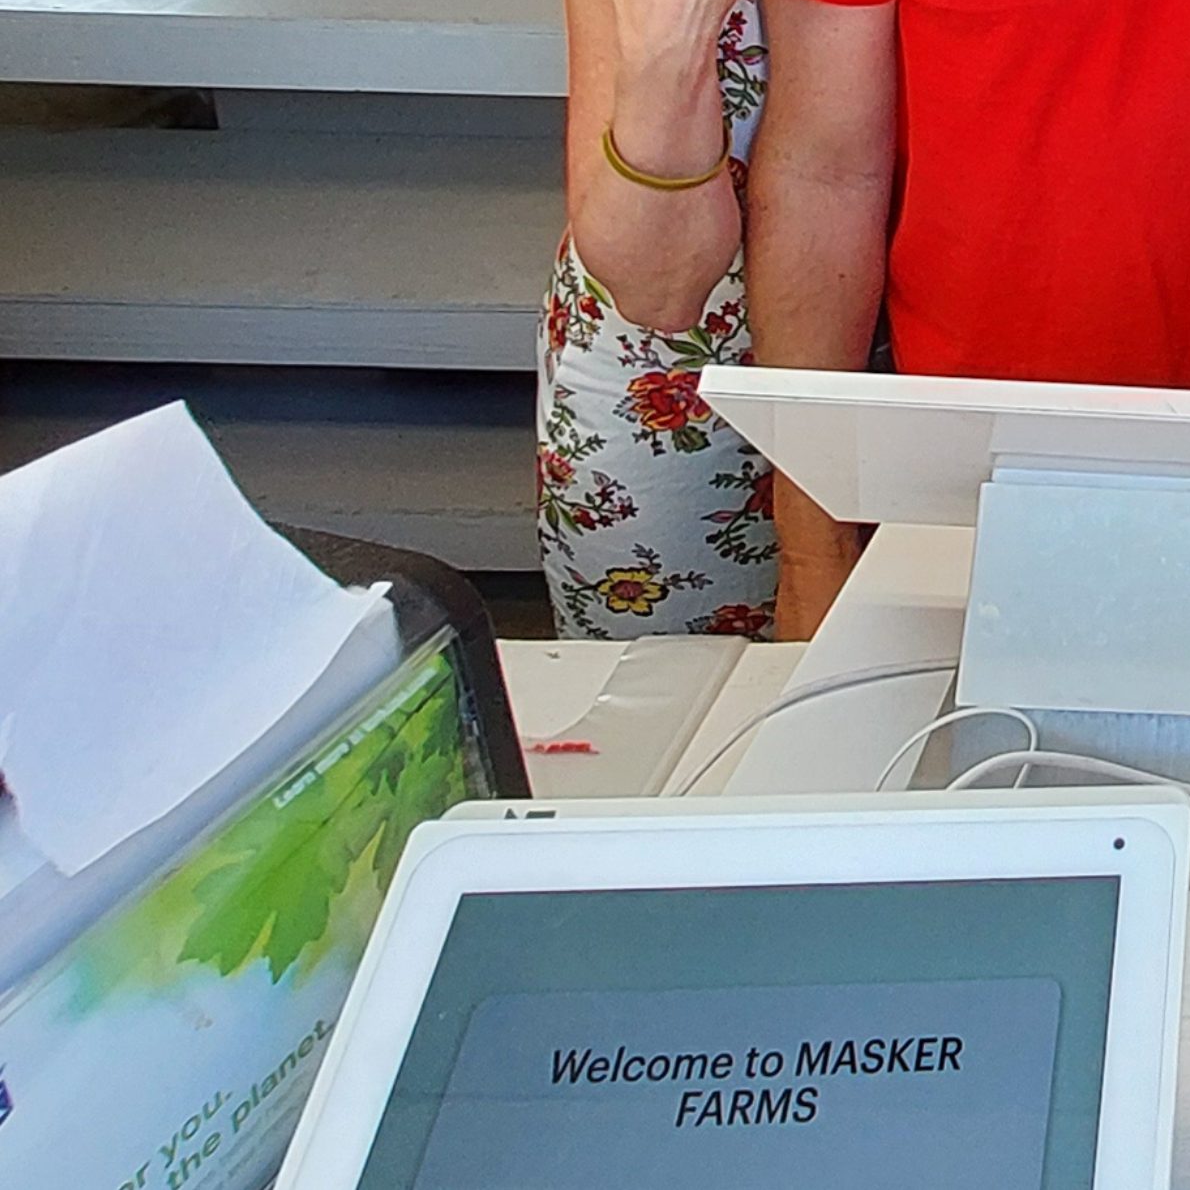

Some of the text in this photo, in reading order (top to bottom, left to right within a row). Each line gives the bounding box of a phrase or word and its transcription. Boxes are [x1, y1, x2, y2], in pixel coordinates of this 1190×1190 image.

[550, 1036, 964, 1085] Welcome to MASKER
[159, 1089, 234, 1168] you.
[674, 1086, 820, 1128] FARMS
[165, 1131, 222, 1190] the
